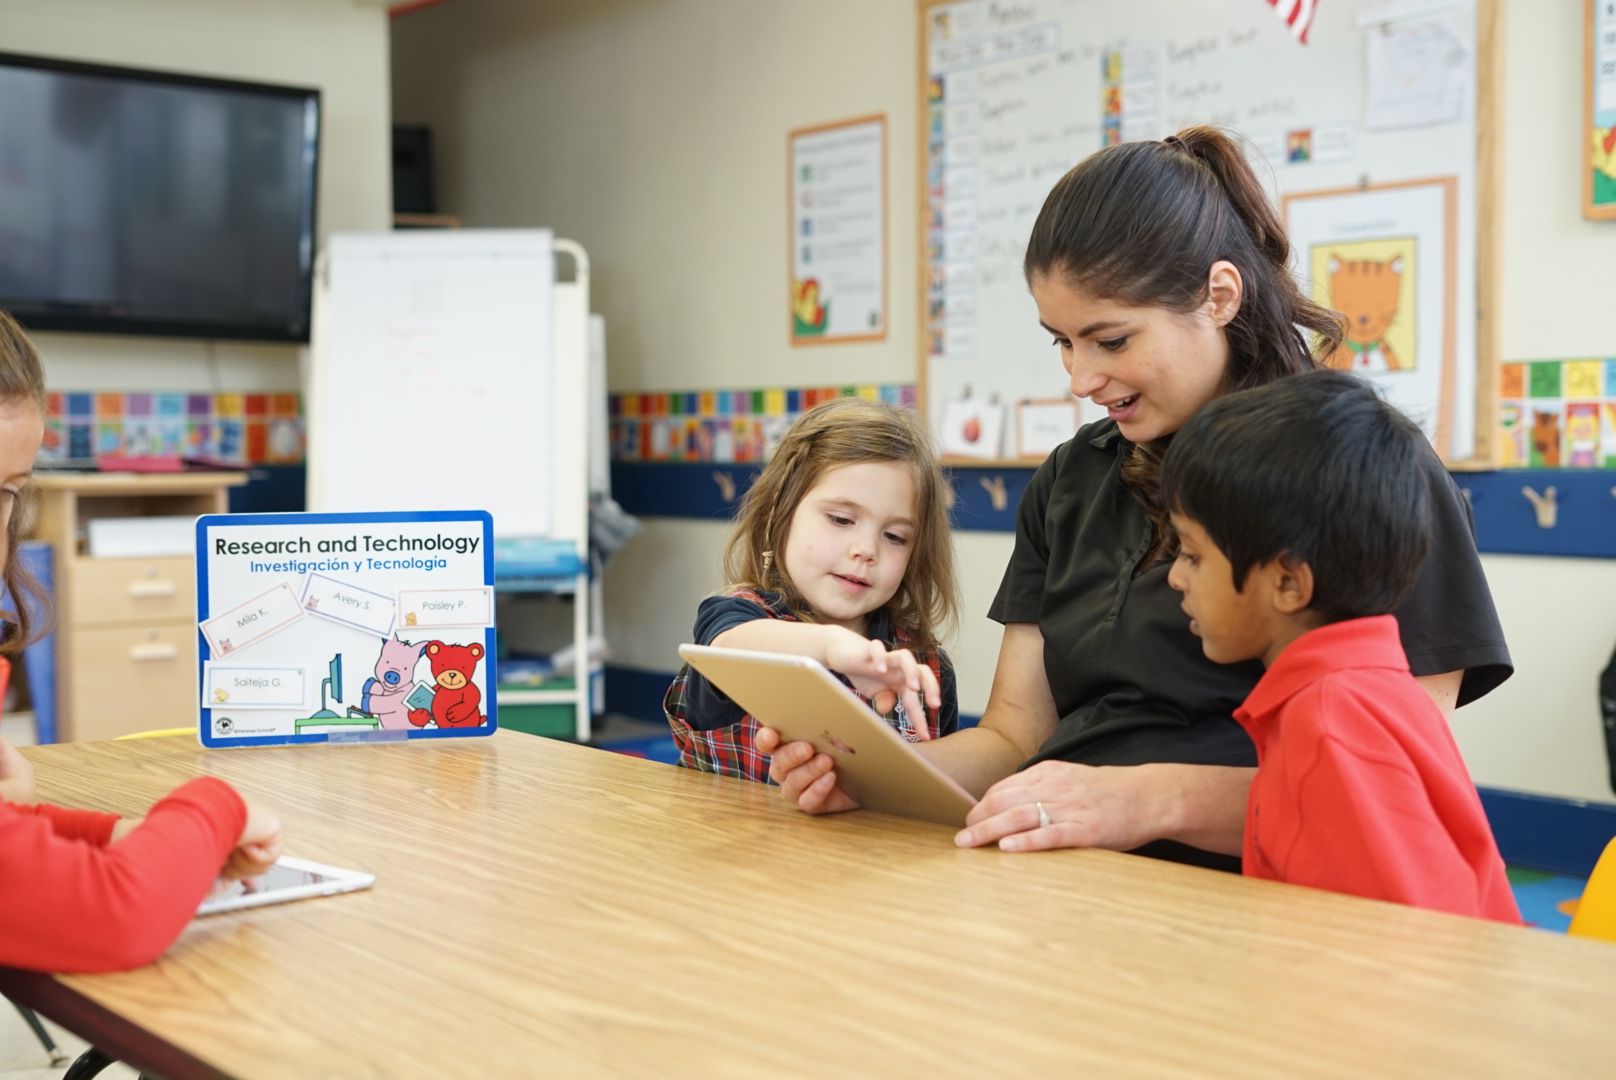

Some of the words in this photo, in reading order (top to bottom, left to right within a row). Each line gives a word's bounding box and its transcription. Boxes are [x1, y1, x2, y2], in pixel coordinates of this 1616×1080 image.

[215, 536, 311, 555] Research
[317, 535, 357, 553] and
[362, 533, 480, 554] Technology
[250, 557, 349, 574] Investigación
[353, 561, 362, 573] y
[366, 555, 447, 572] Tecnología
[333, 592, 361, 608] Avery
[363, 601, 372, 611] S.
[422, 601, 456, 611] Paisley
[458, 600, 467, 610] P.
[237, 612, 258, 628] Mila
[257, 607, 270, 617] K.
[234, 677, 269, 689] Saiteja
[271, 677, 284, 687] G.
